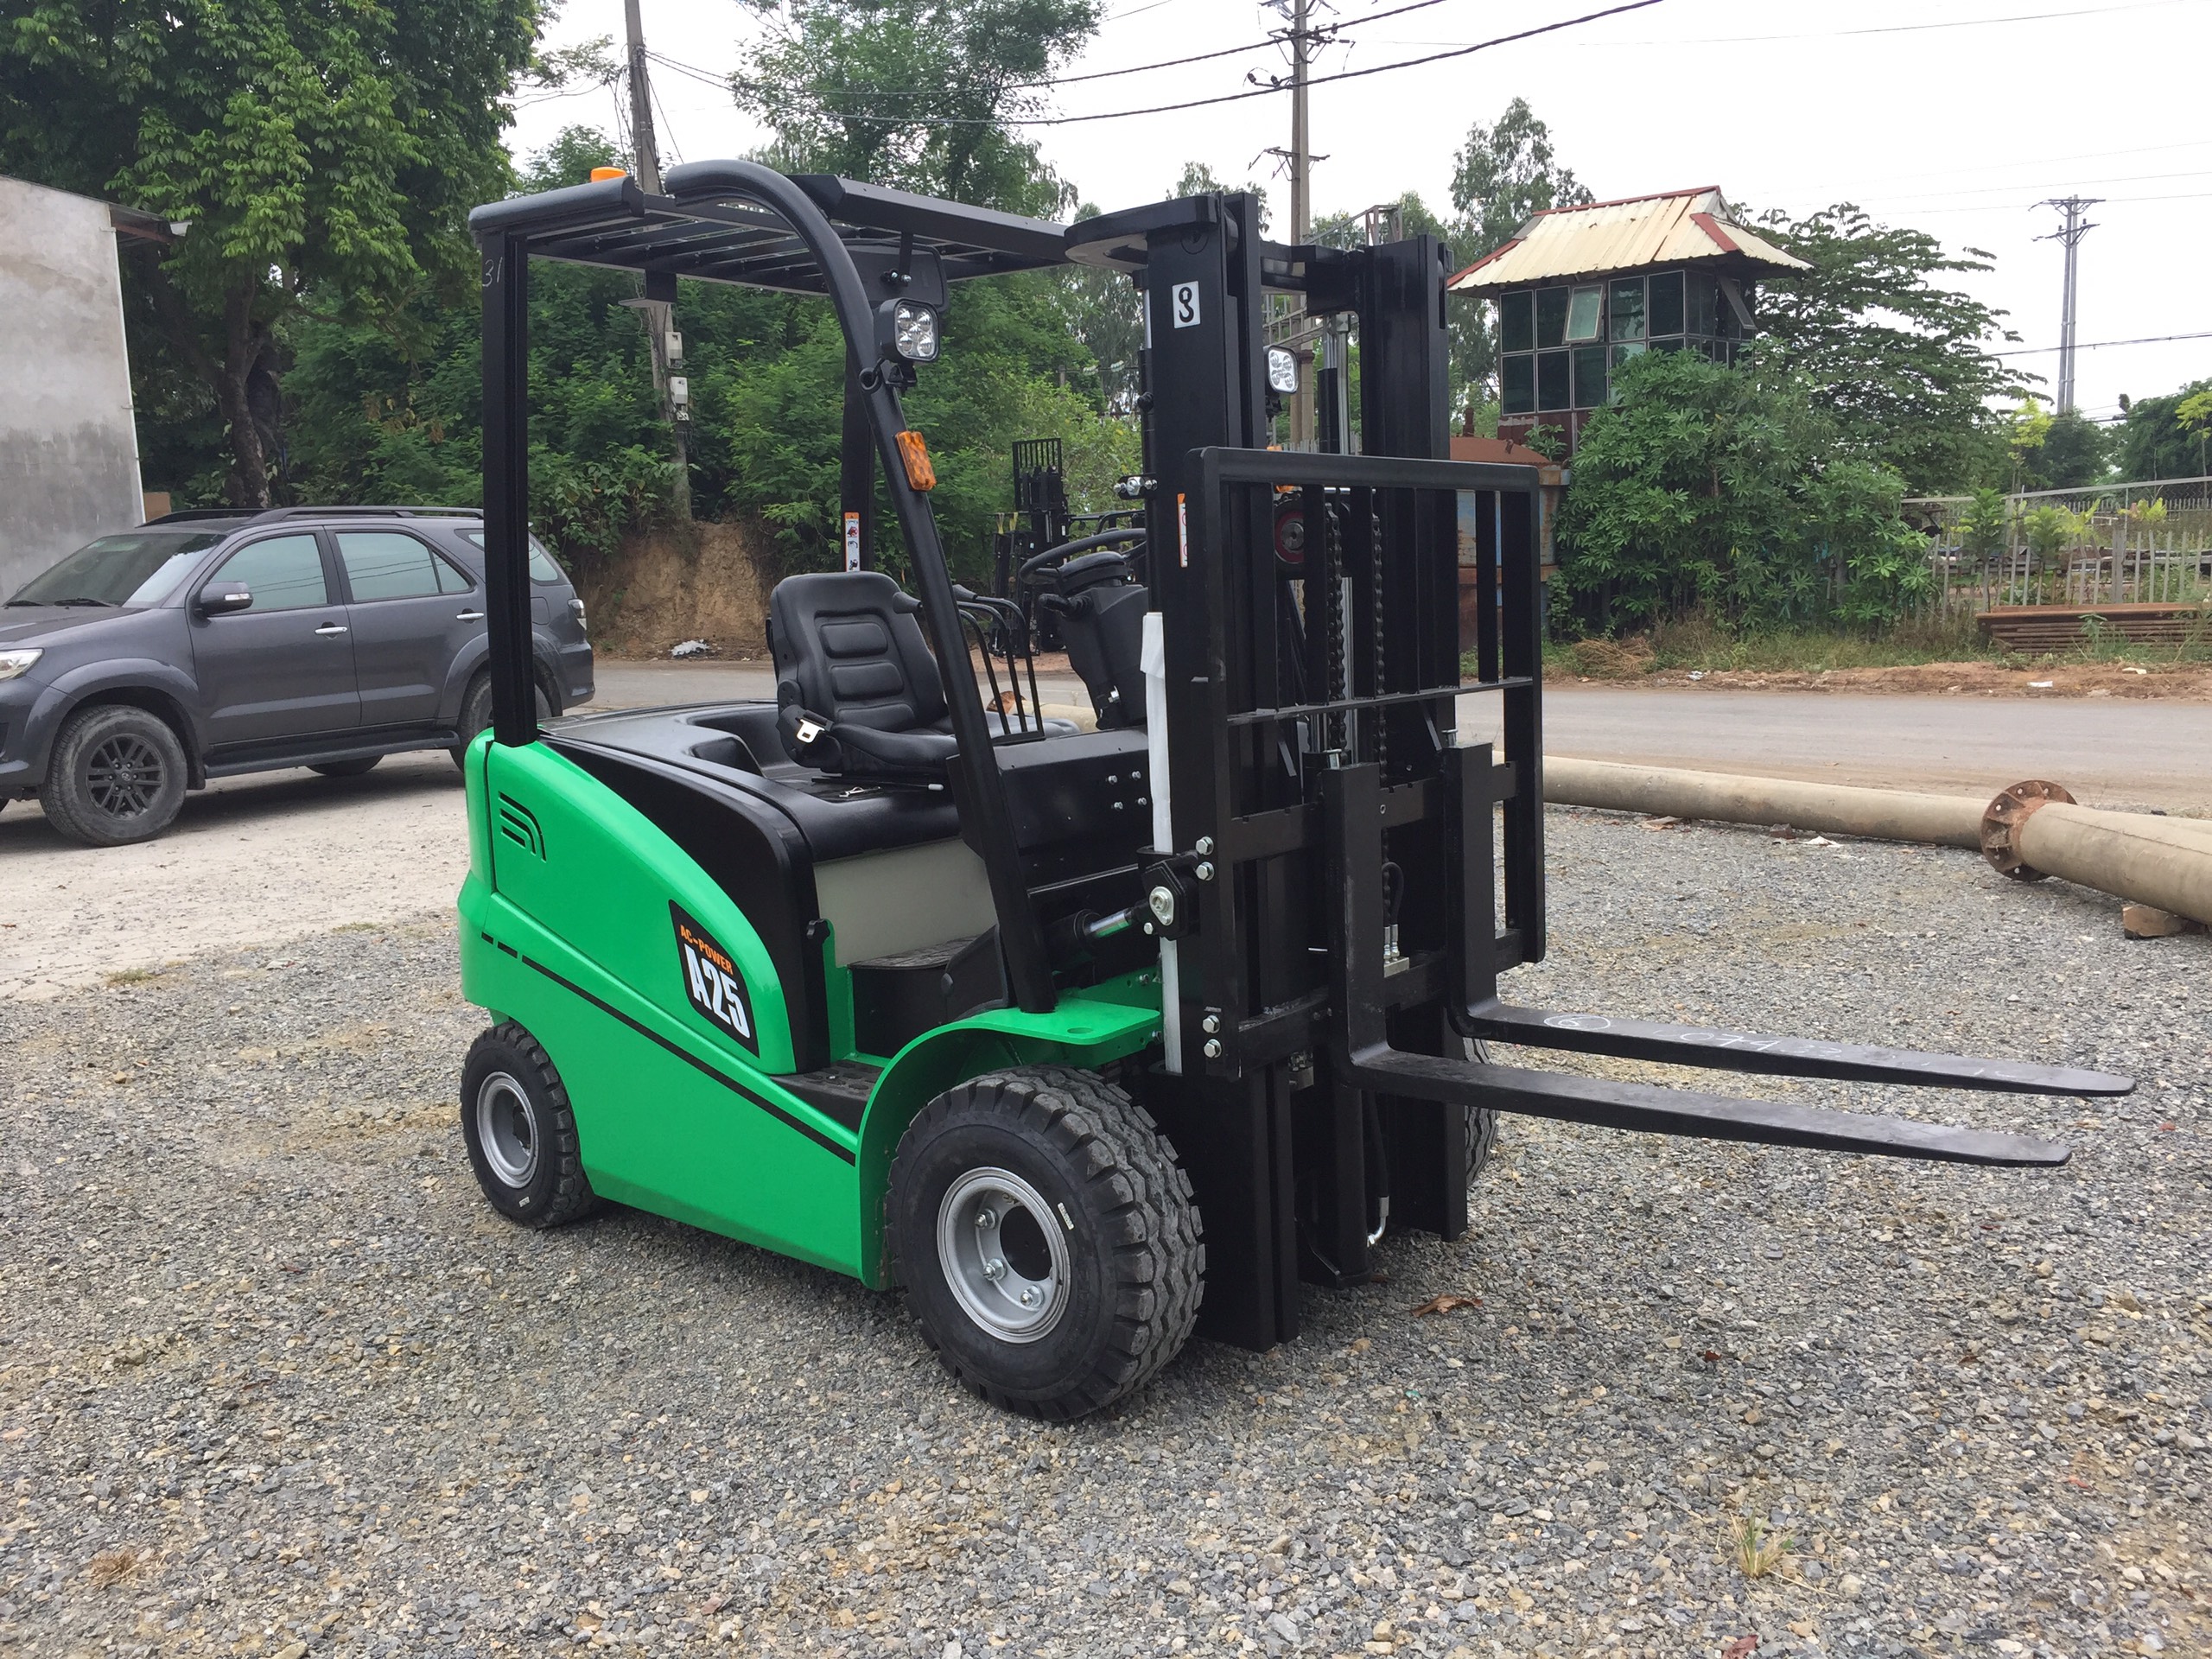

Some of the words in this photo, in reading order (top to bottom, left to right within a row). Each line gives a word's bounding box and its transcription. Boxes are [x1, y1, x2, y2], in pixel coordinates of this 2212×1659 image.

[482, 257, 503, 287] 31
[680, 924, 734, 976] AC-POWER
[684, 944, 751, 1039] A25
